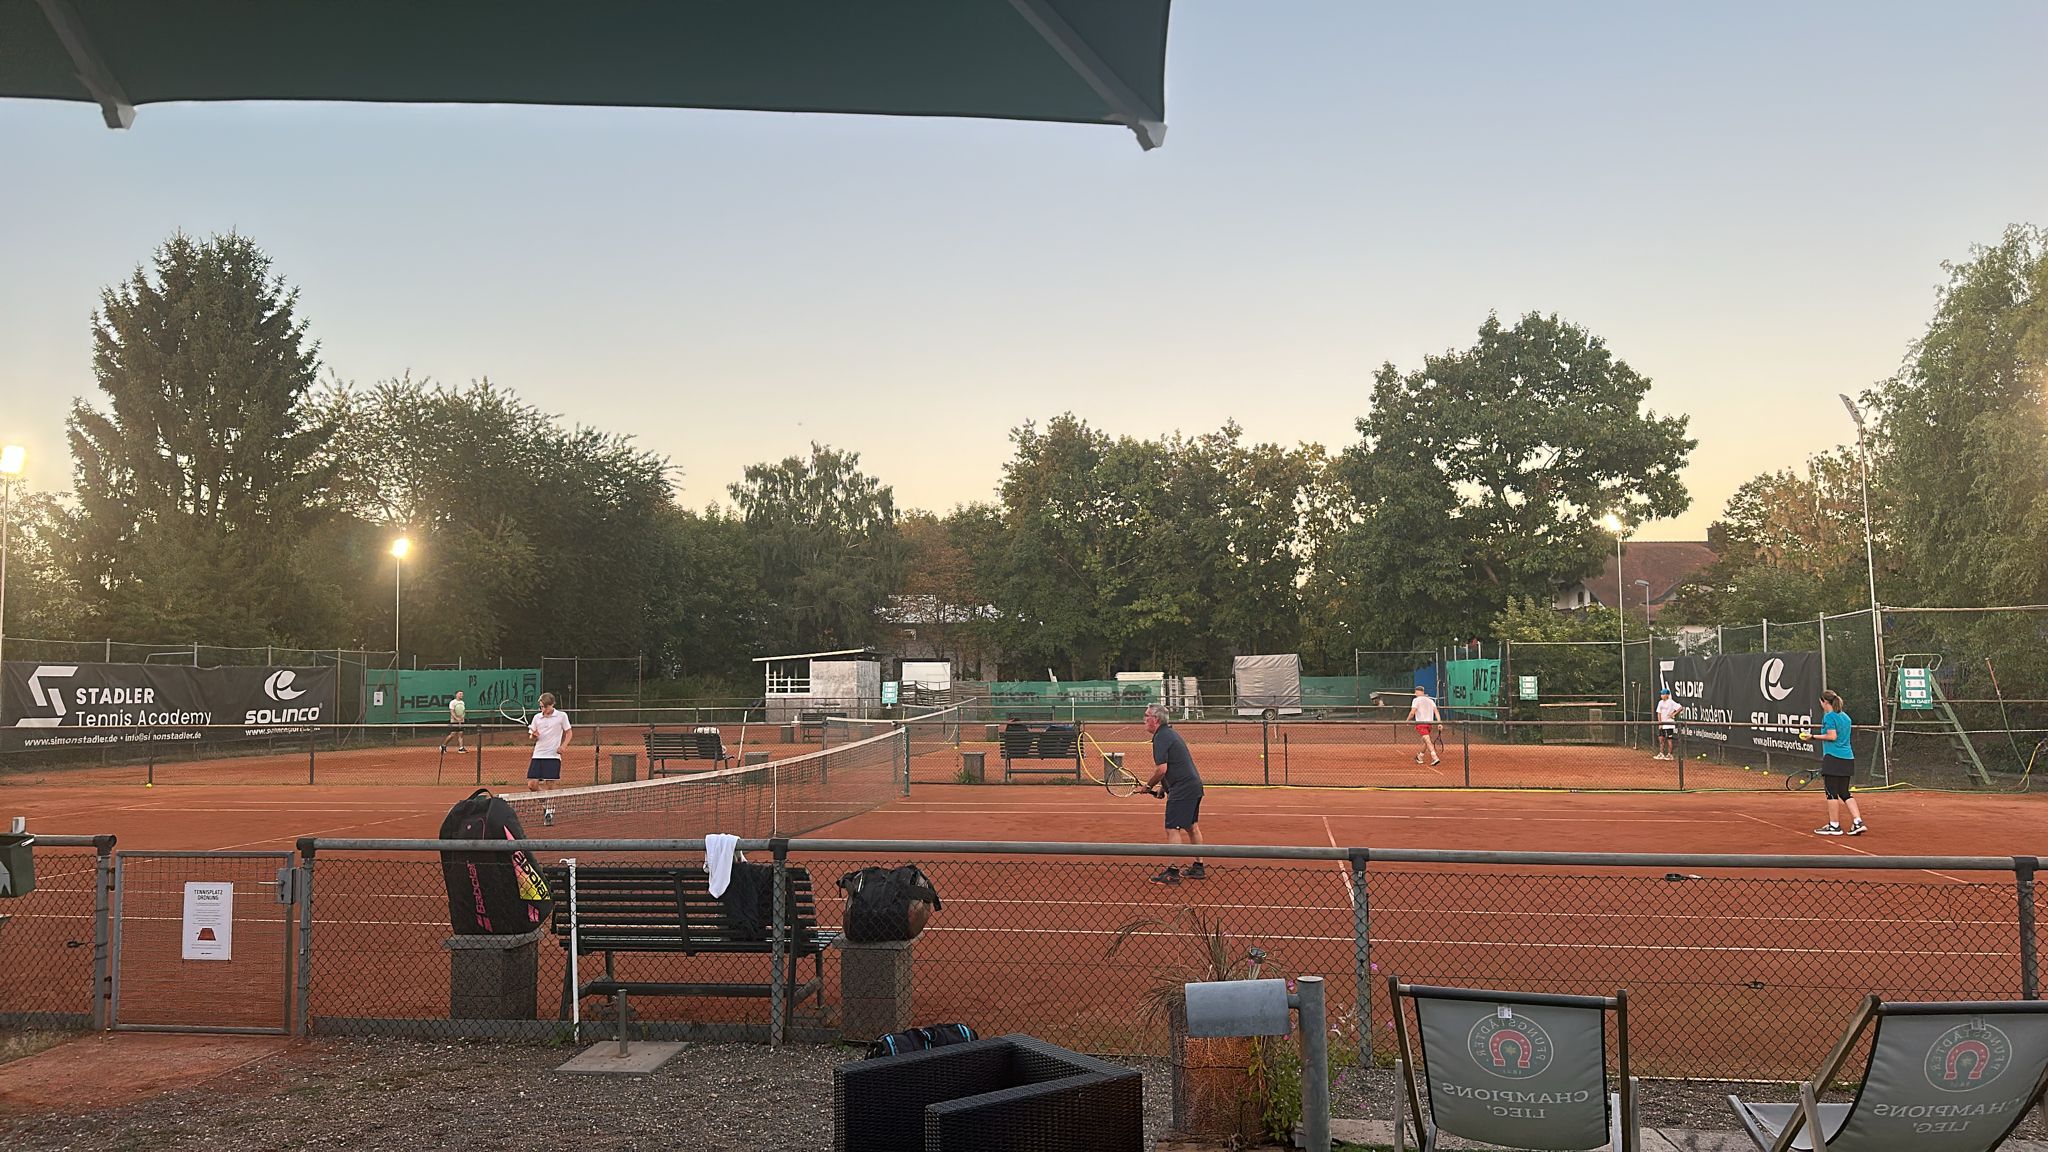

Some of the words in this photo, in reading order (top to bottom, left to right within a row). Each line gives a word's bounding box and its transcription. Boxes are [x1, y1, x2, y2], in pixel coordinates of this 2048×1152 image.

[76, 687, 155, 705] STADLER
[400, 694, 454, 709] HEAD
[75, 709, 132, 727] Tennis
[137, 708, 212, 727] Academy
[244, 706, 320, 724] SOLINCO
